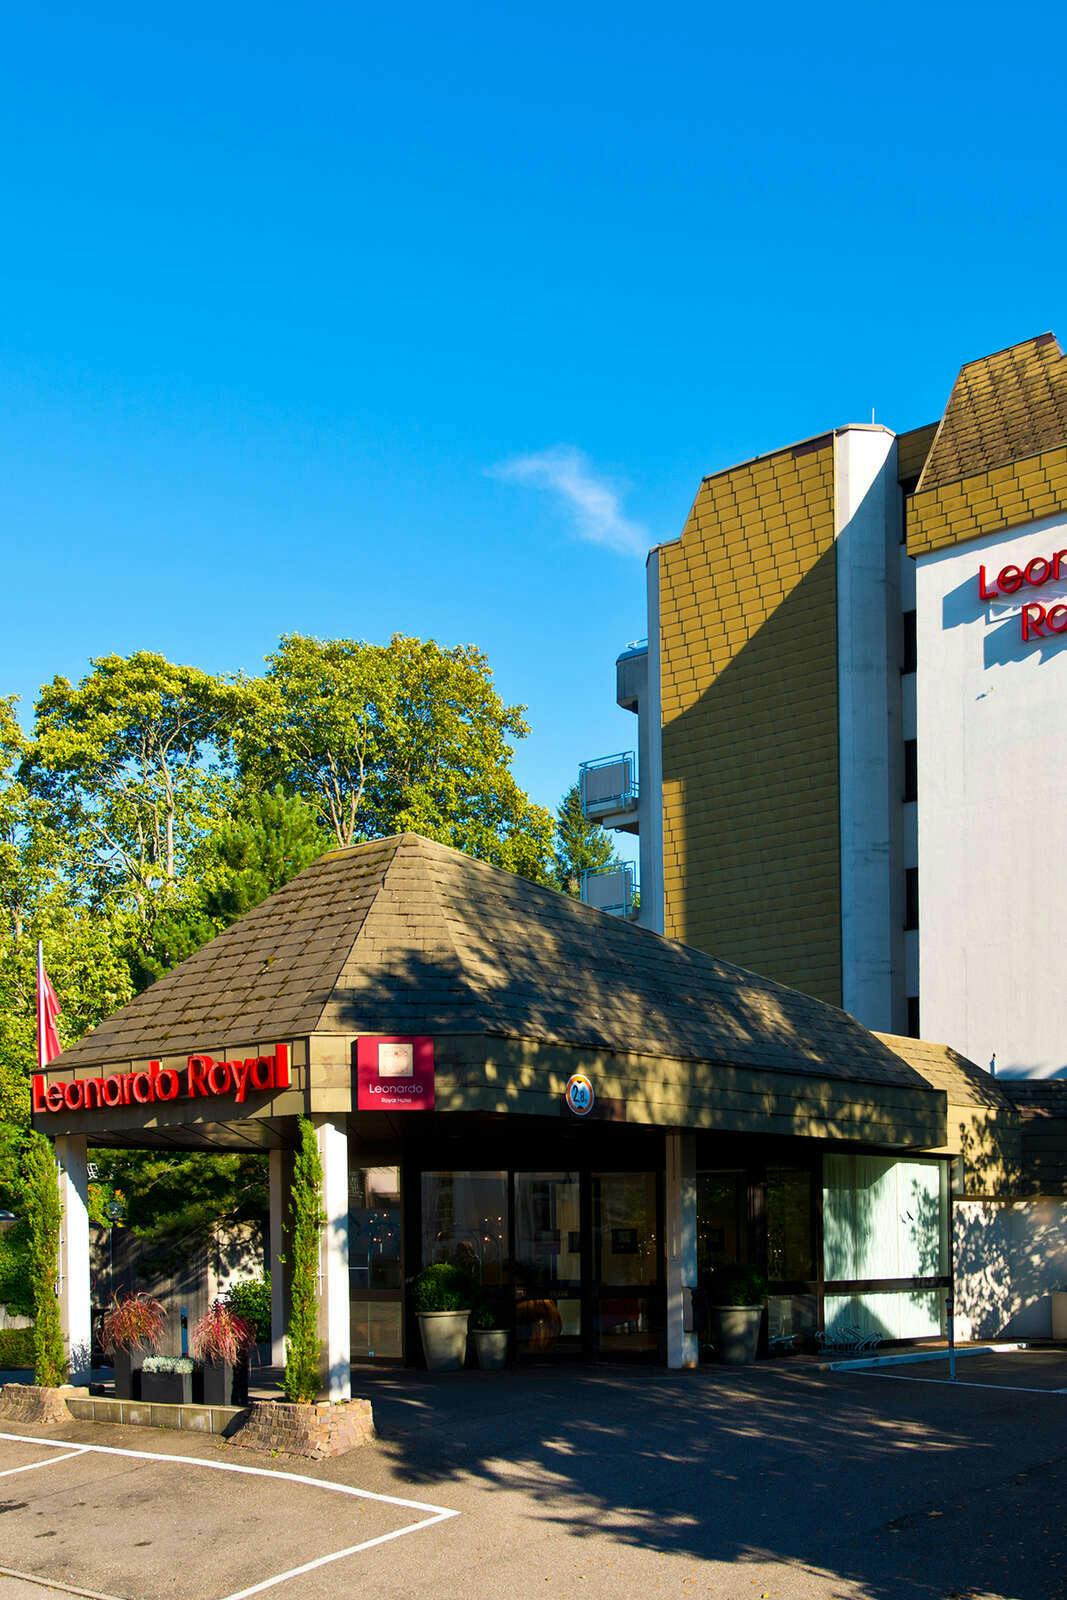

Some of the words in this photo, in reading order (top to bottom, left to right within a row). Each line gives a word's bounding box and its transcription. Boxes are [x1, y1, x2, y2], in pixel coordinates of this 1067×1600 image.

[33, 1061, 179, 1113] Leonardo
[188, 1044, 291, 1102] Royal
[369, 1083, 423, 1094] Leonardo
